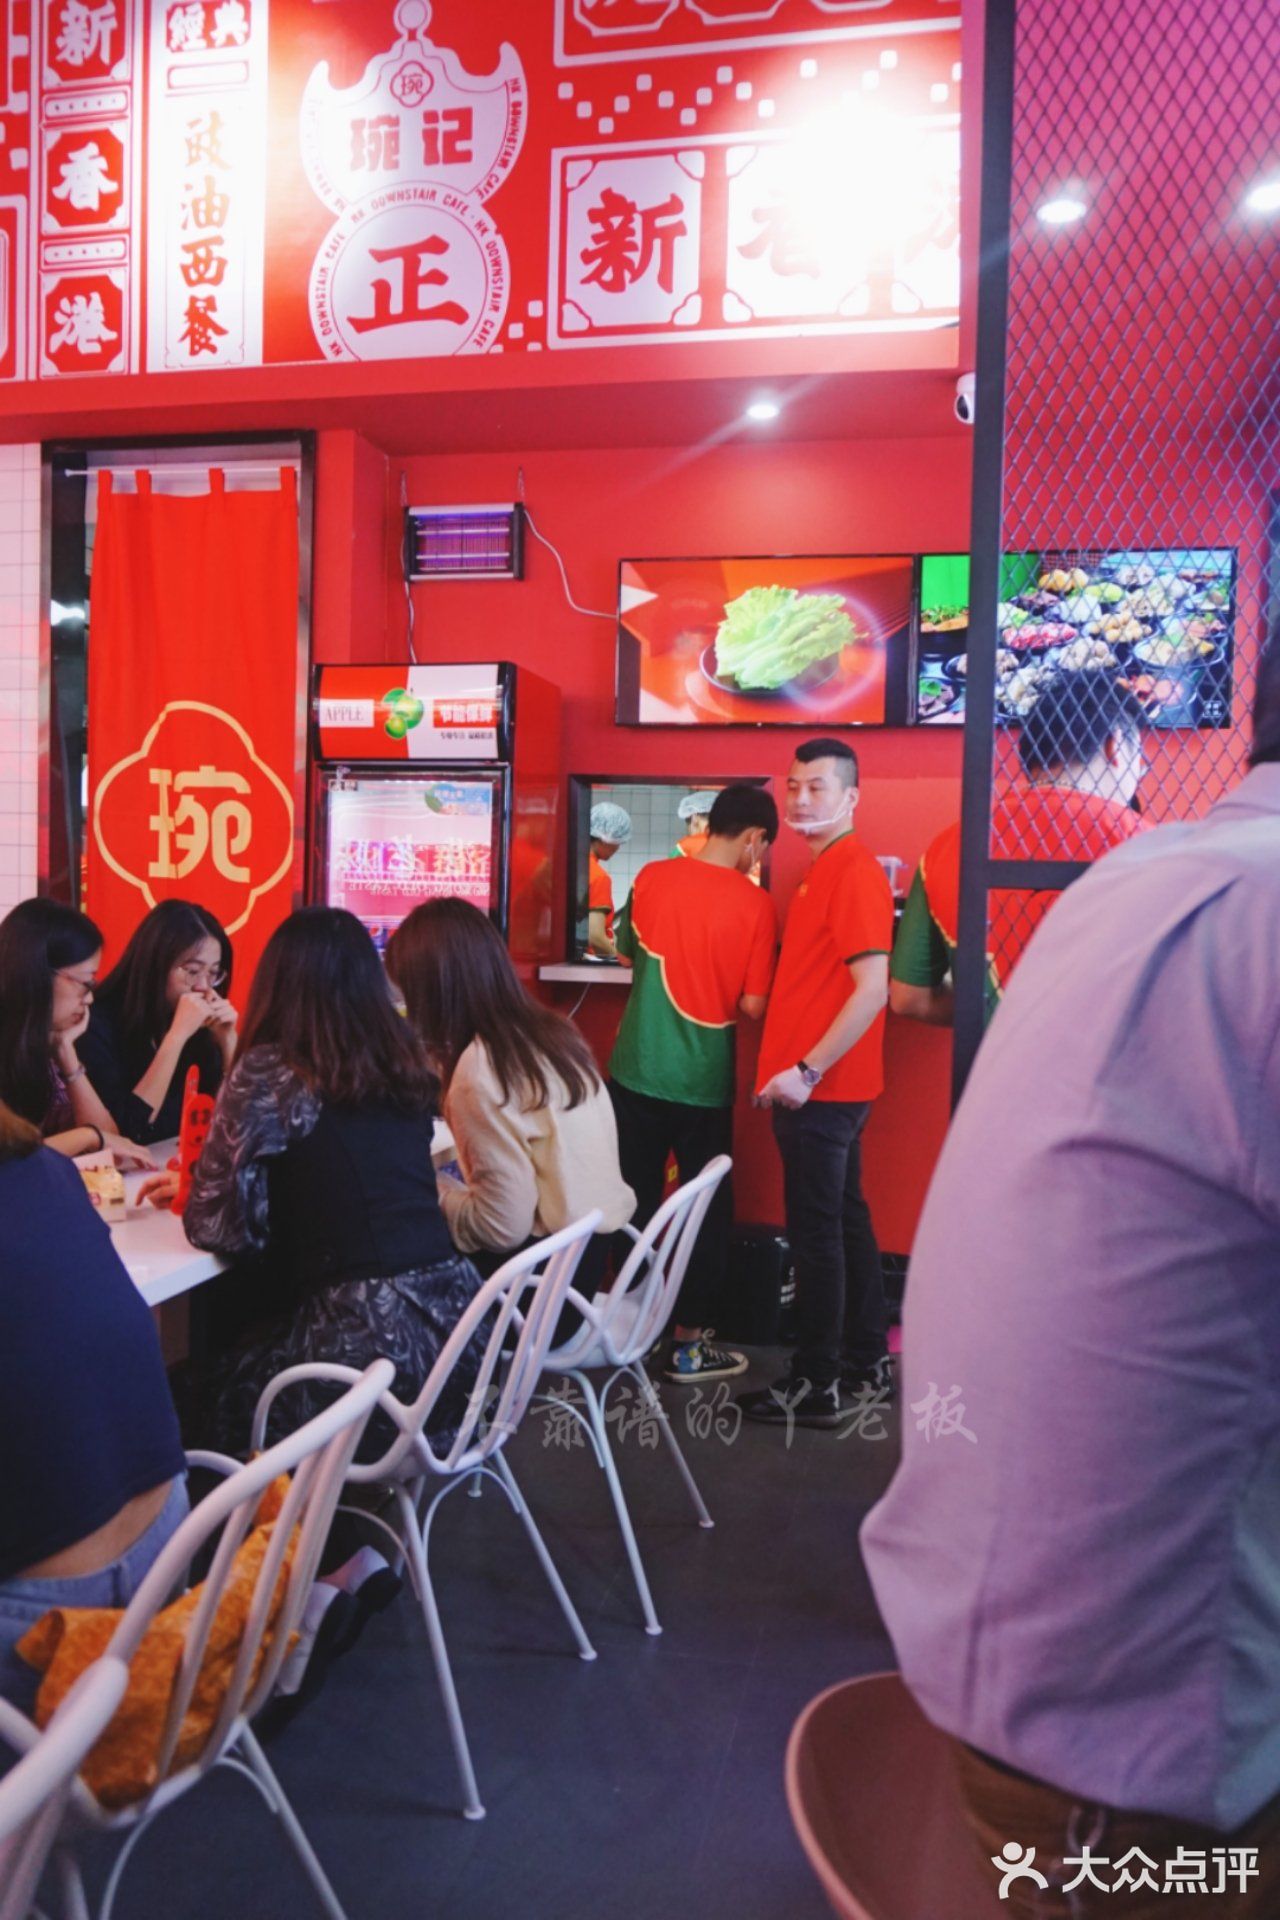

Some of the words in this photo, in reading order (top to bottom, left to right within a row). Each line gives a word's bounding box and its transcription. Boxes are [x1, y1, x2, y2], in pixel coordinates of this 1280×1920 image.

[371, 188, 437, 211] DOWNSTAIR
[442, 193, 470, 216] CAFE
[474, 219, 490, 237] HK
[325, 233, 346, 259] CAFE
[346, 234, 470, 334] 正
[485, 241, 504, 314] DOWNSTAIR
[315, 267, 332, 337] DOWNSTAIR
[473, 320, 495, 348] CAFE
[328, 341, 343, 357] HK
